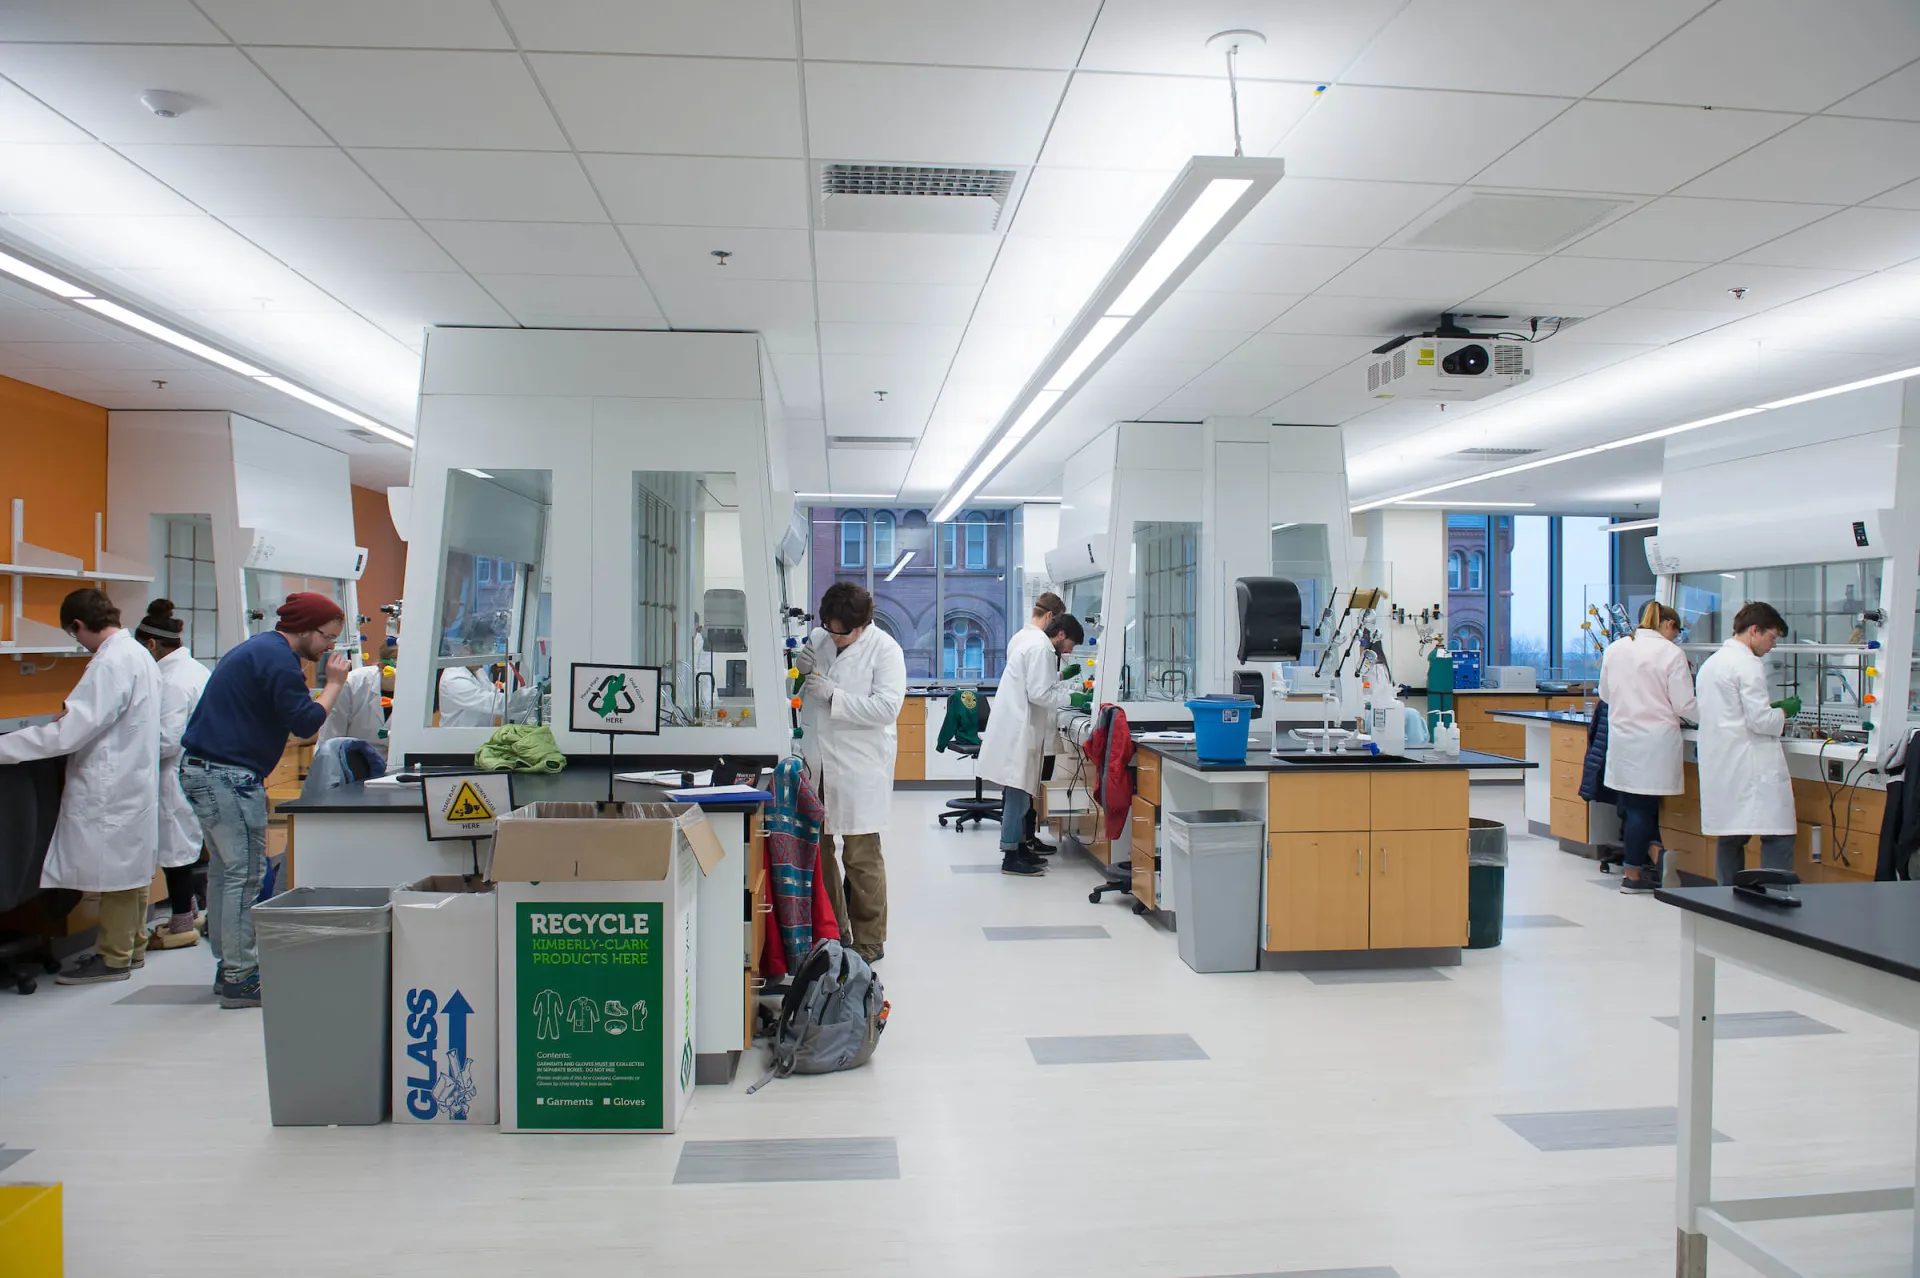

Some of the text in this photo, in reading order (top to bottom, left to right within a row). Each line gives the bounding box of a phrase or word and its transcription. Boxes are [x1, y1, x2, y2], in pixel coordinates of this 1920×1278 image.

[590, 677, 599, 687] Place
[441, 785, 457, 812] PLEASE PLACE
[474, 782, 496, 812] BROKEN GLASS
[530, 914, 649, 934] RECYCLE
[532, 939, 649, 950] KIMBERLY-CLARK
[532, 953, 648, 964] PRODUCTS HERE
[406, 988, 438, 1120] GLASS
[536, 1051, 572, 1059] Contents:
[546, 1098, 646, 1106] Garments Gloves
